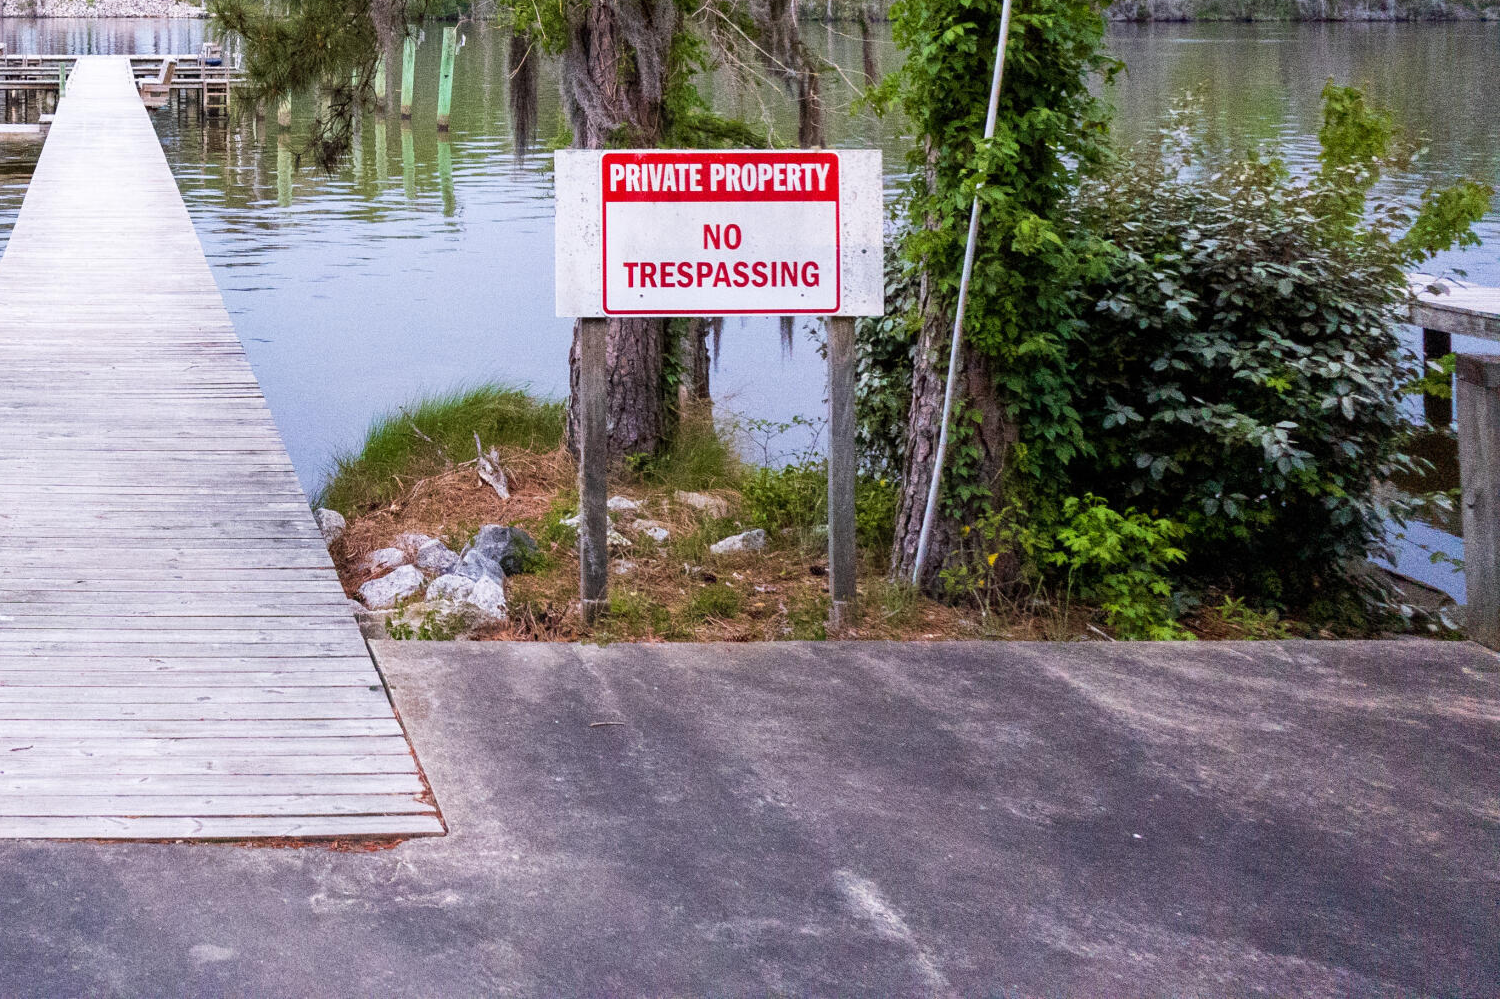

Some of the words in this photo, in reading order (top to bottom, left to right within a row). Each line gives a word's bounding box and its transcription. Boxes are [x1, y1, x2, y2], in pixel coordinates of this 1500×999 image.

[609, 163, 703, 192] PRIVATE
[710, 163, 830, 192] PROPERTY
[703, 223, 742, 250] NO
[623, 261, 820, 288] TRESPASSING
